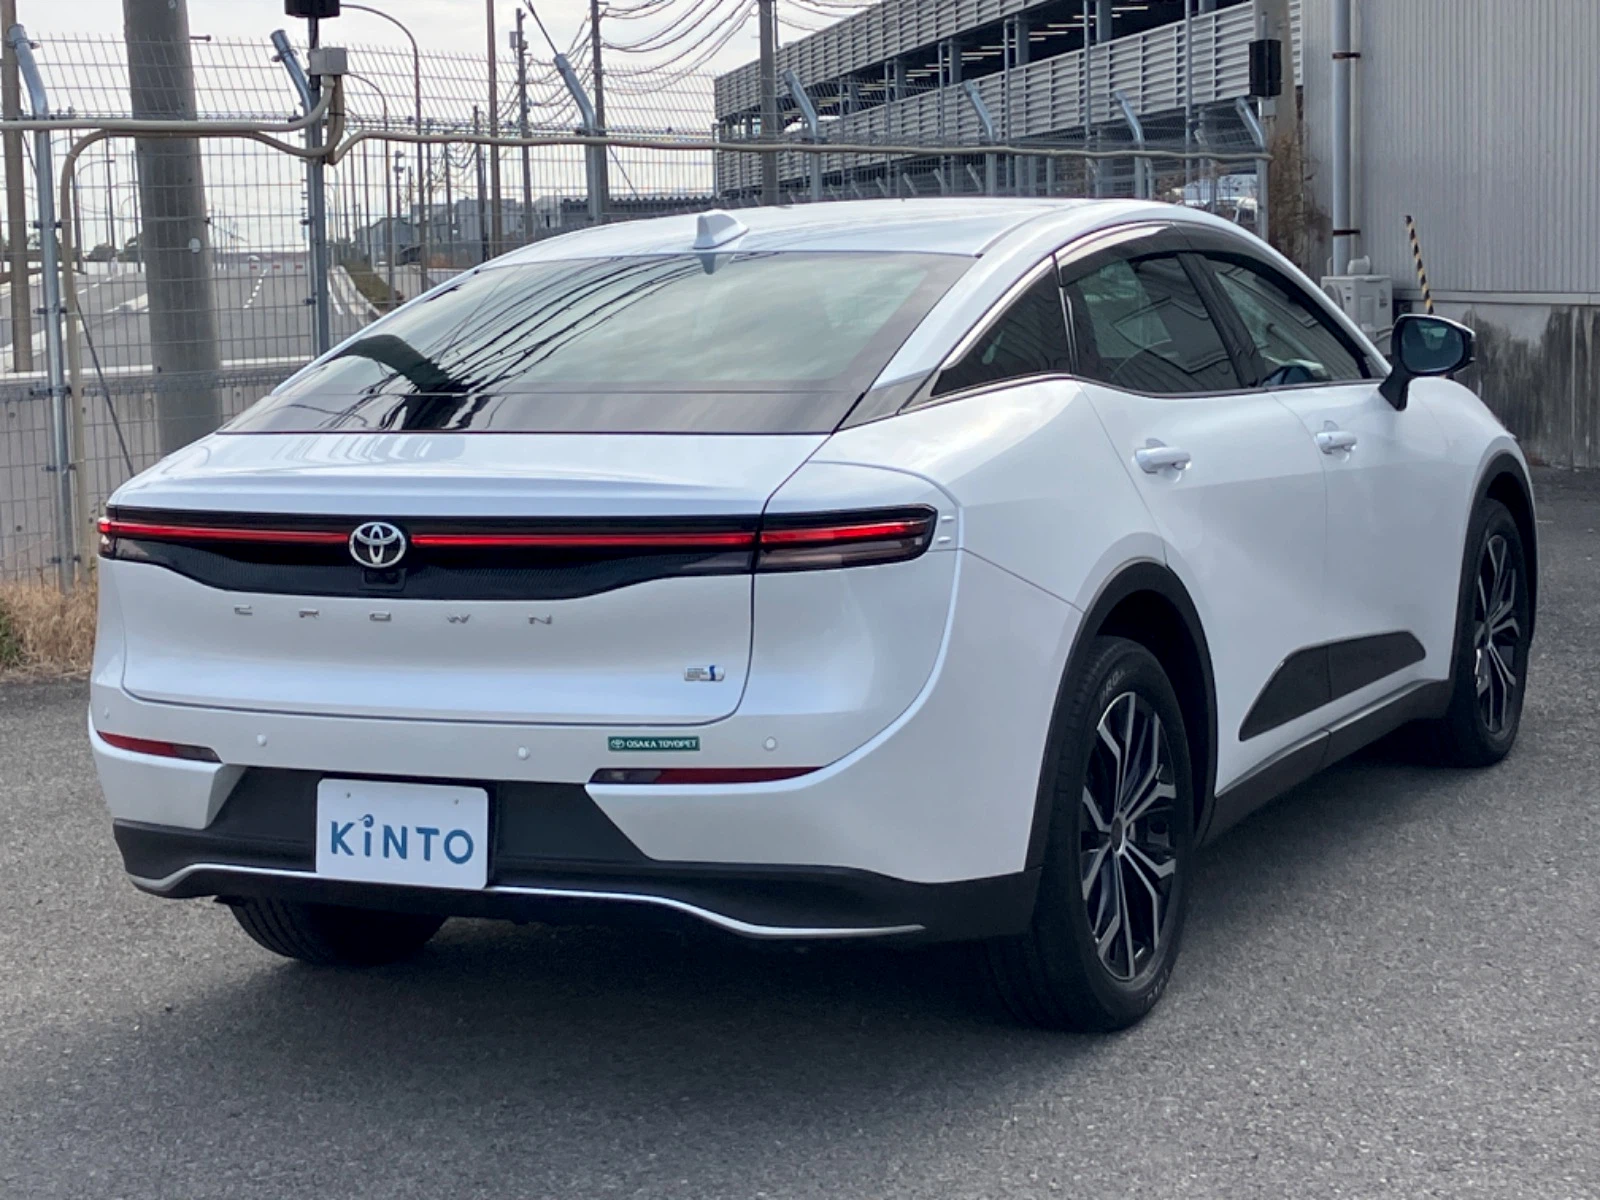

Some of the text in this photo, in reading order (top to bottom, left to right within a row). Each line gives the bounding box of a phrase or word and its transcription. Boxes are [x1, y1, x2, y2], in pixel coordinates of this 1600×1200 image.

[234, 604, 553, 625] CROWN
[626, 739, 697, 749] OSAKA TOYOPET
